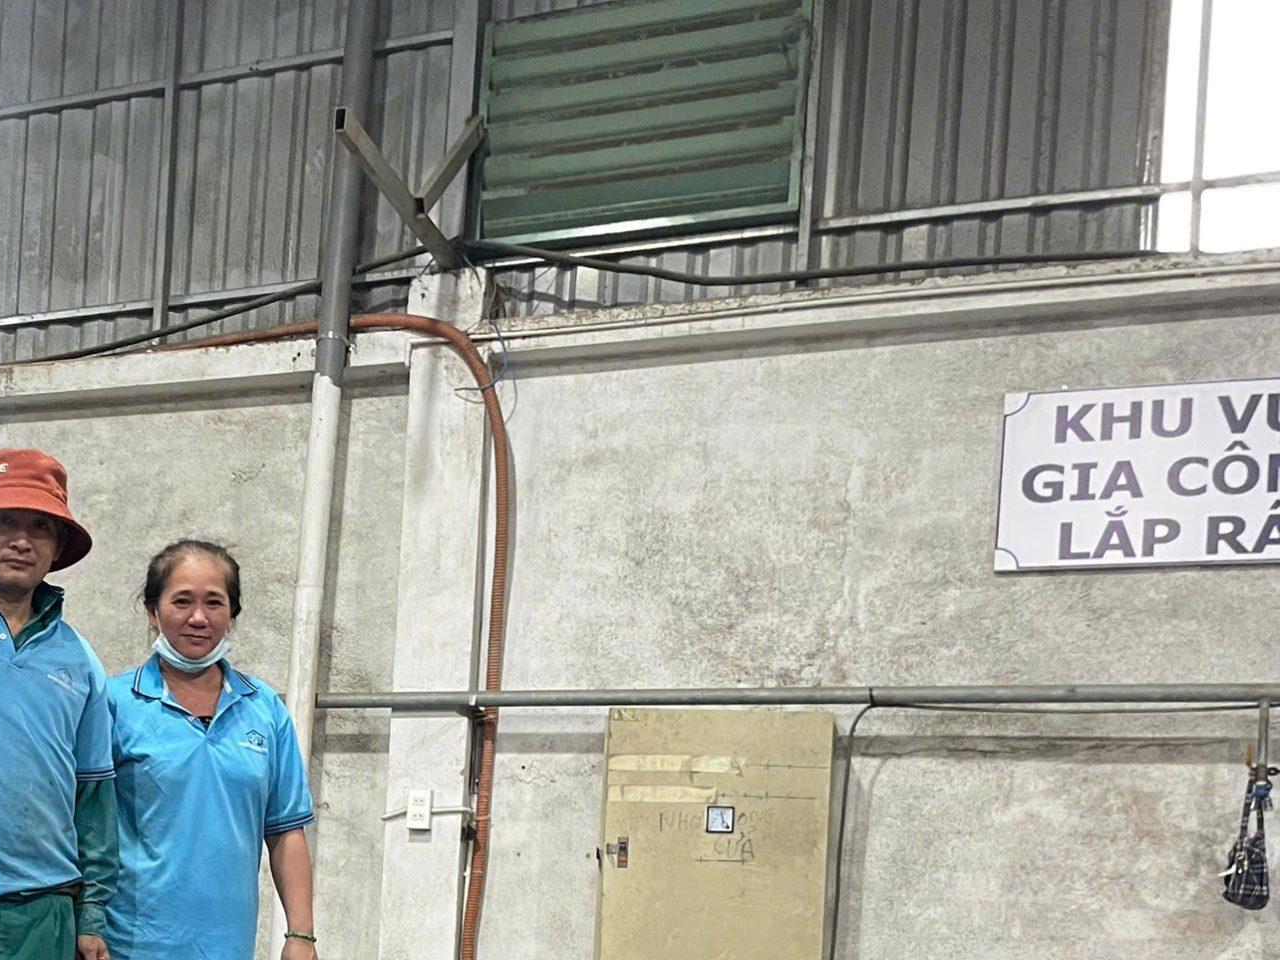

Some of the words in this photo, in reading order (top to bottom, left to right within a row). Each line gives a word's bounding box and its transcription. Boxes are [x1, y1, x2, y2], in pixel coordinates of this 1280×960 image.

[1054, 397, 1194, 443] KHU
[1021, 460, 1144, 503] GIA
[1058, 505, 1181, 560] LẮP
